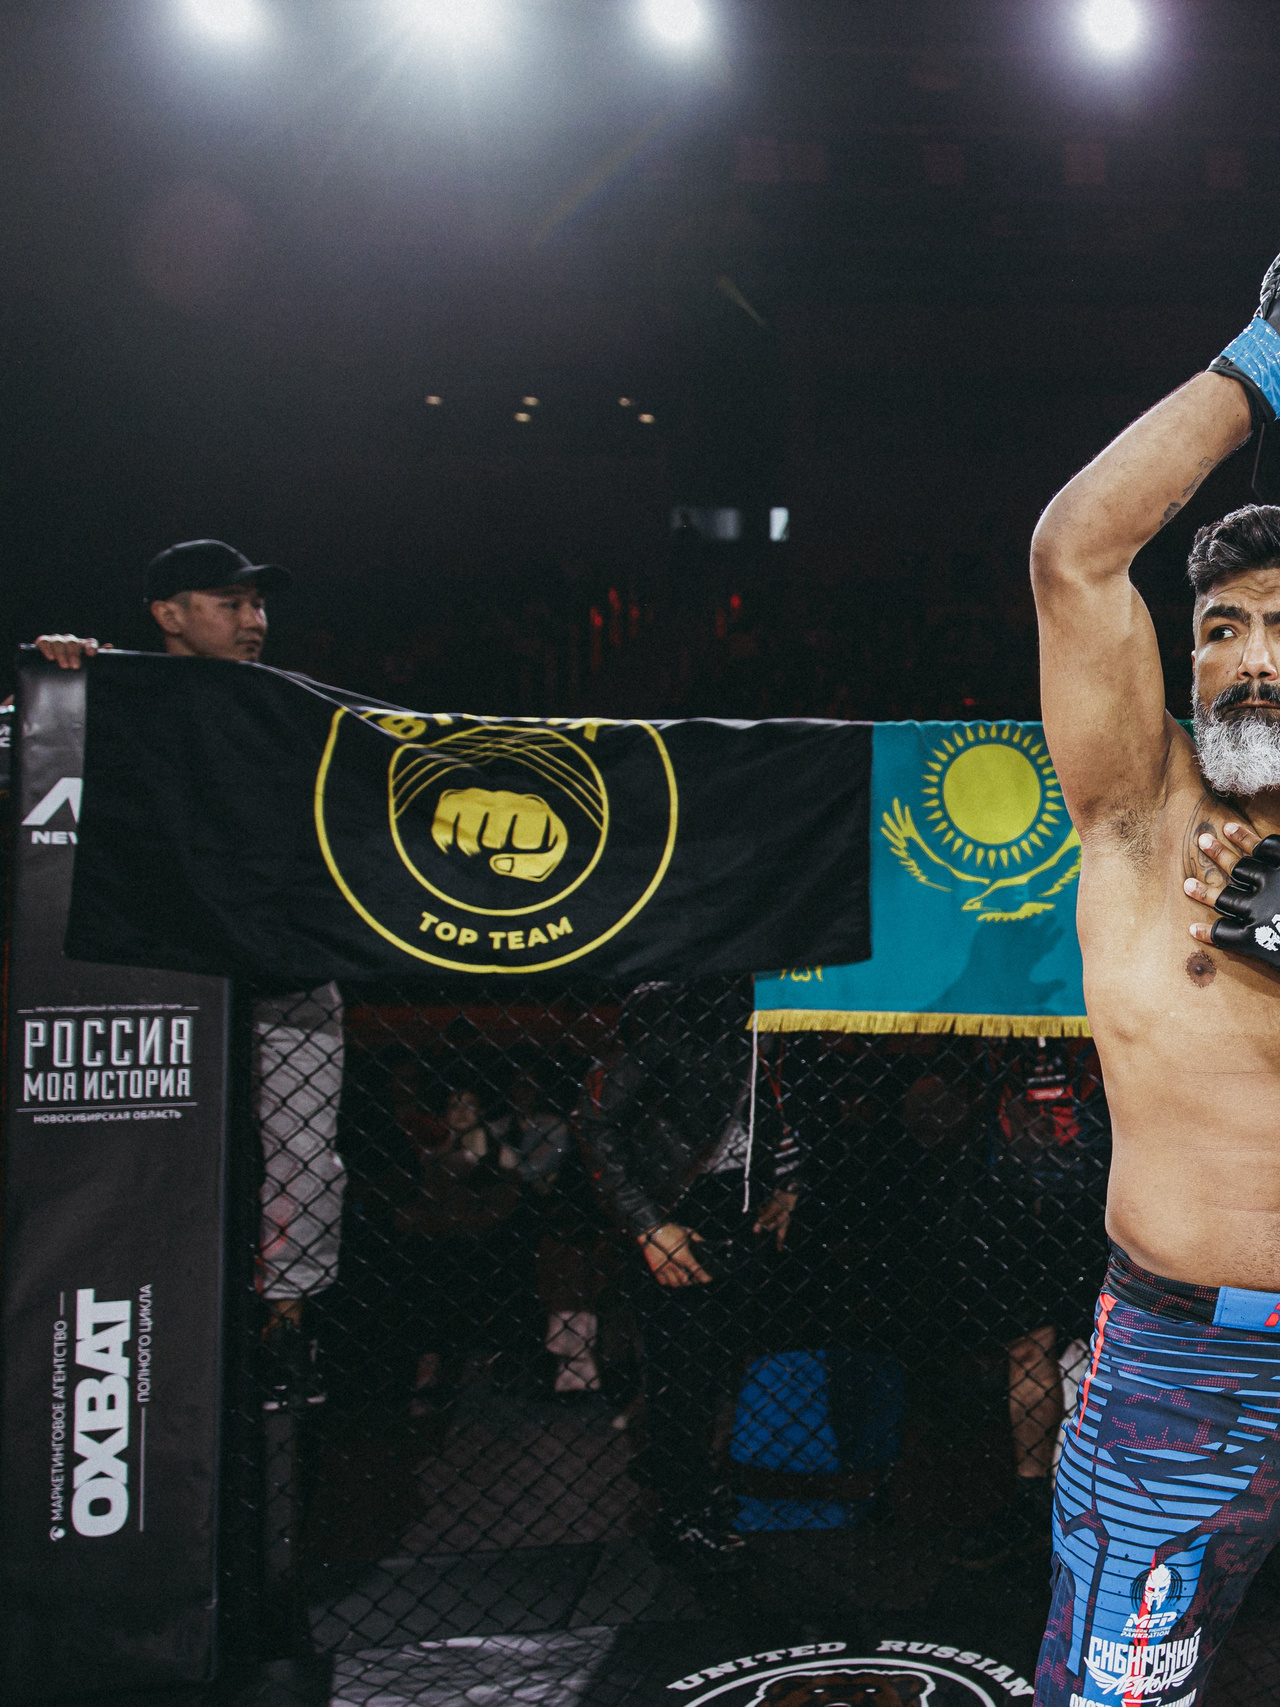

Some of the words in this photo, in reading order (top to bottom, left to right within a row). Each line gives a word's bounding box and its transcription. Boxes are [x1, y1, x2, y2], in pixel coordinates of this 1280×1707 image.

[419, 911, 478, 946] TOP
[488, 916, 573, 950] TEAM
[24, 1016, 192, 1069] РОССИЯ
[24, 1072, 77, 1102] МОЯ
[84, 1069, 191, 1100] ИСТОРИЯ
[33, 1111, 130, 1124] НОВОСИБИРСКАЯ
[133, 1109, 182, 1121] ОБЛАСТЬ
[139, 1284, 153, 1332] ЦИКЛА
[53, 1320, 68, 1400] АГЕНТСТВО
[137, 1334, 152, 1403] ПОЛНОГО
[71, 1288, 131, 1537] ОХВАТ
[51, 1402, 66, 1522] МАРКЕТИНГОВОЕ
[1120, 1630, 1171, 1638] PANKRATION
[1125, 1611, 1178, 1628] MFP
[666, 1641, 848, 1691] UNITED
[875, 1640, 1035, 1697] RUSSIAN
[1088, 1626, 1202, 1676] СИБИРСКИЙ
